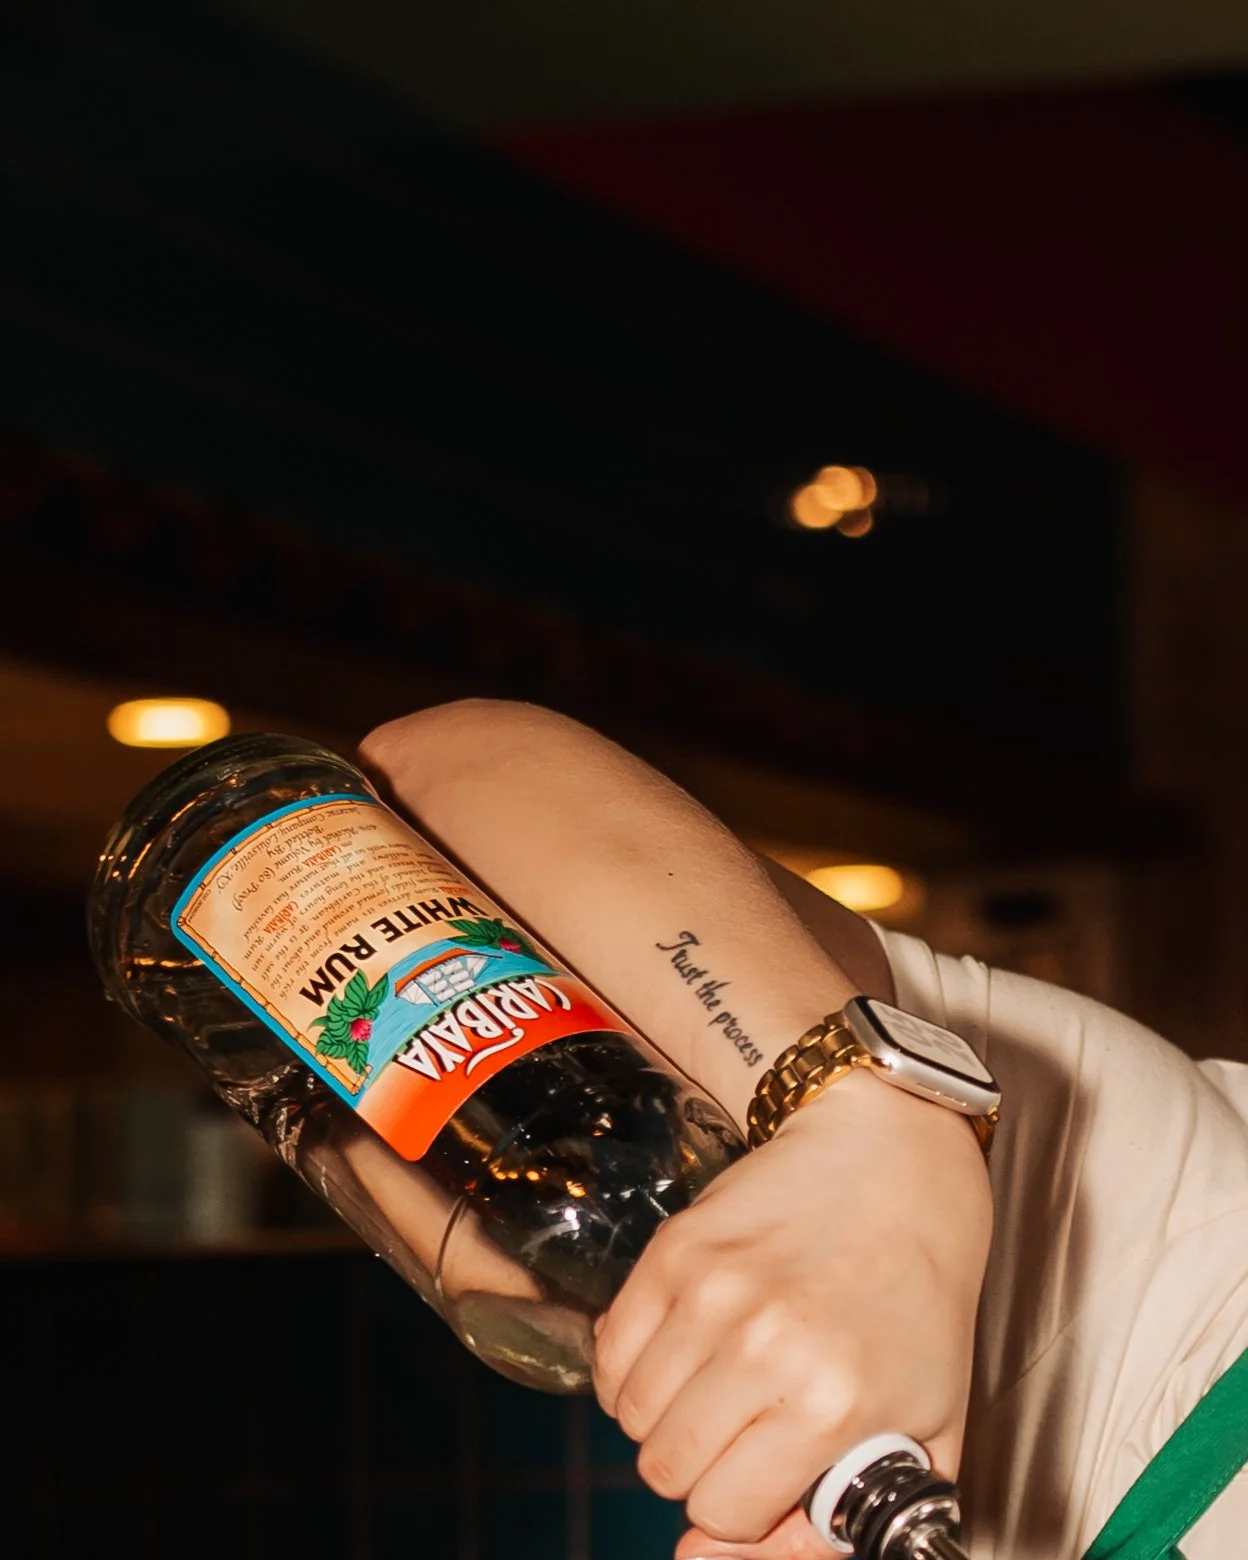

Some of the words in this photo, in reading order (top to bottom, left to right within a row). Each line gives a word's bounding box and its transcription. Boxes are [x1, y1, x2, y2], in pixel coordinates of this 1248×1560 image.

[284, 824, 325, 850] Bottled
[305, 836, 326, 849] by
[322, 826, 358, 844] Alcohol
[264, 843, 286, 859] By
[272, 844, 311, 870] Volume
[301, 844, 344, 868] CARIBAYA
[256, 865, 276, 884] (80
[344, 858, 366, 872] and
[365, 864, 386, 877] and
[288, 868, 320, 892] nature
[299, 870, 340, 898] matures
[323, 880, 350, 896] long
[348, 872, 367, 884] the
[360, 878, 380, 890] the
[272, 890, 290, 905] has
[298, 894, 326, 916] hours
[354, 882, 392, 909] formed
[376, 890, 412, 908] derives
[242, 904, 275, 942] lavished
[262, 900, 300, 936] CARIBAYA
[320, 903, 355, 934] around
[332, 916, 360, 938] name
[370, 896, 489, 943] WHITE
[264, 925, 288, 952] warm
[302, 928, 322, 950] and
[308, 931, 334, 959] from
[250, 953, 265, 972] sun
[274, 944, 290, 962] the
[280, 946, 305, 974] about
[655, 931, 708, 985] Trust
[260, 960, 276, 982] salt
[294, 958, 310, 977] the
[299, 934, 376, 1006] RUM
[268, 972, 284, 990] the
[278, 976, 296, 1000] rich
[694, 980, 732, 1012] the
[397, 978, 571, 1080] CARIBAYA
[707, 1010, 764, 1068] process
